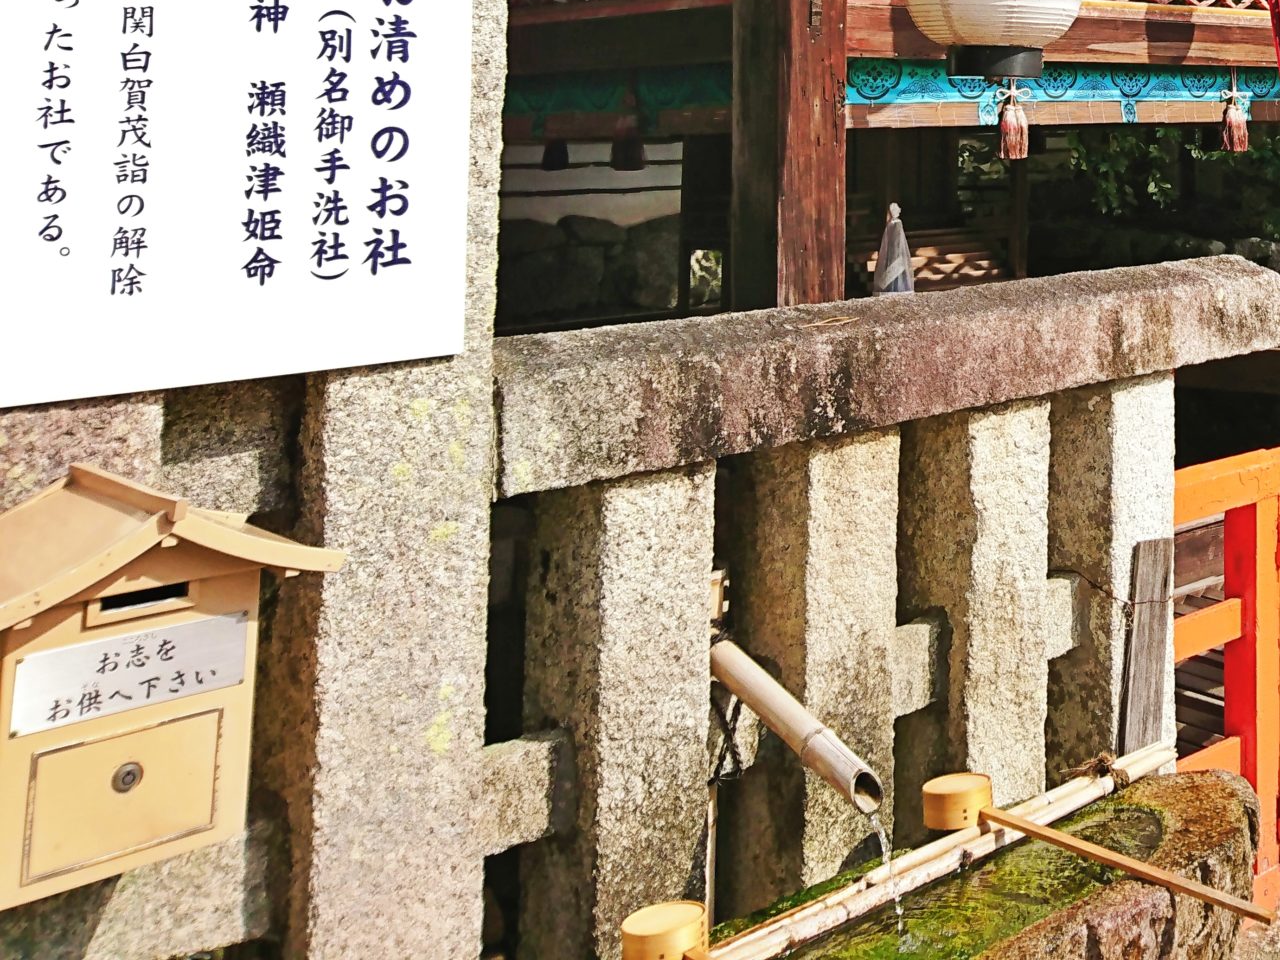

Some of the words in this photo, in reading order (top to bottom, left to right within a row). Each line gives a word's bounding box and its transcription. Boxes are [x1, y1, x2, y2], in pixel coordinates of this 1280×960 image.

[241, 80, 287, 286] 瀬織津姫命
[96, 639, 177, 675] お志を
[46, 668, 217, 722] お供へ下さい
